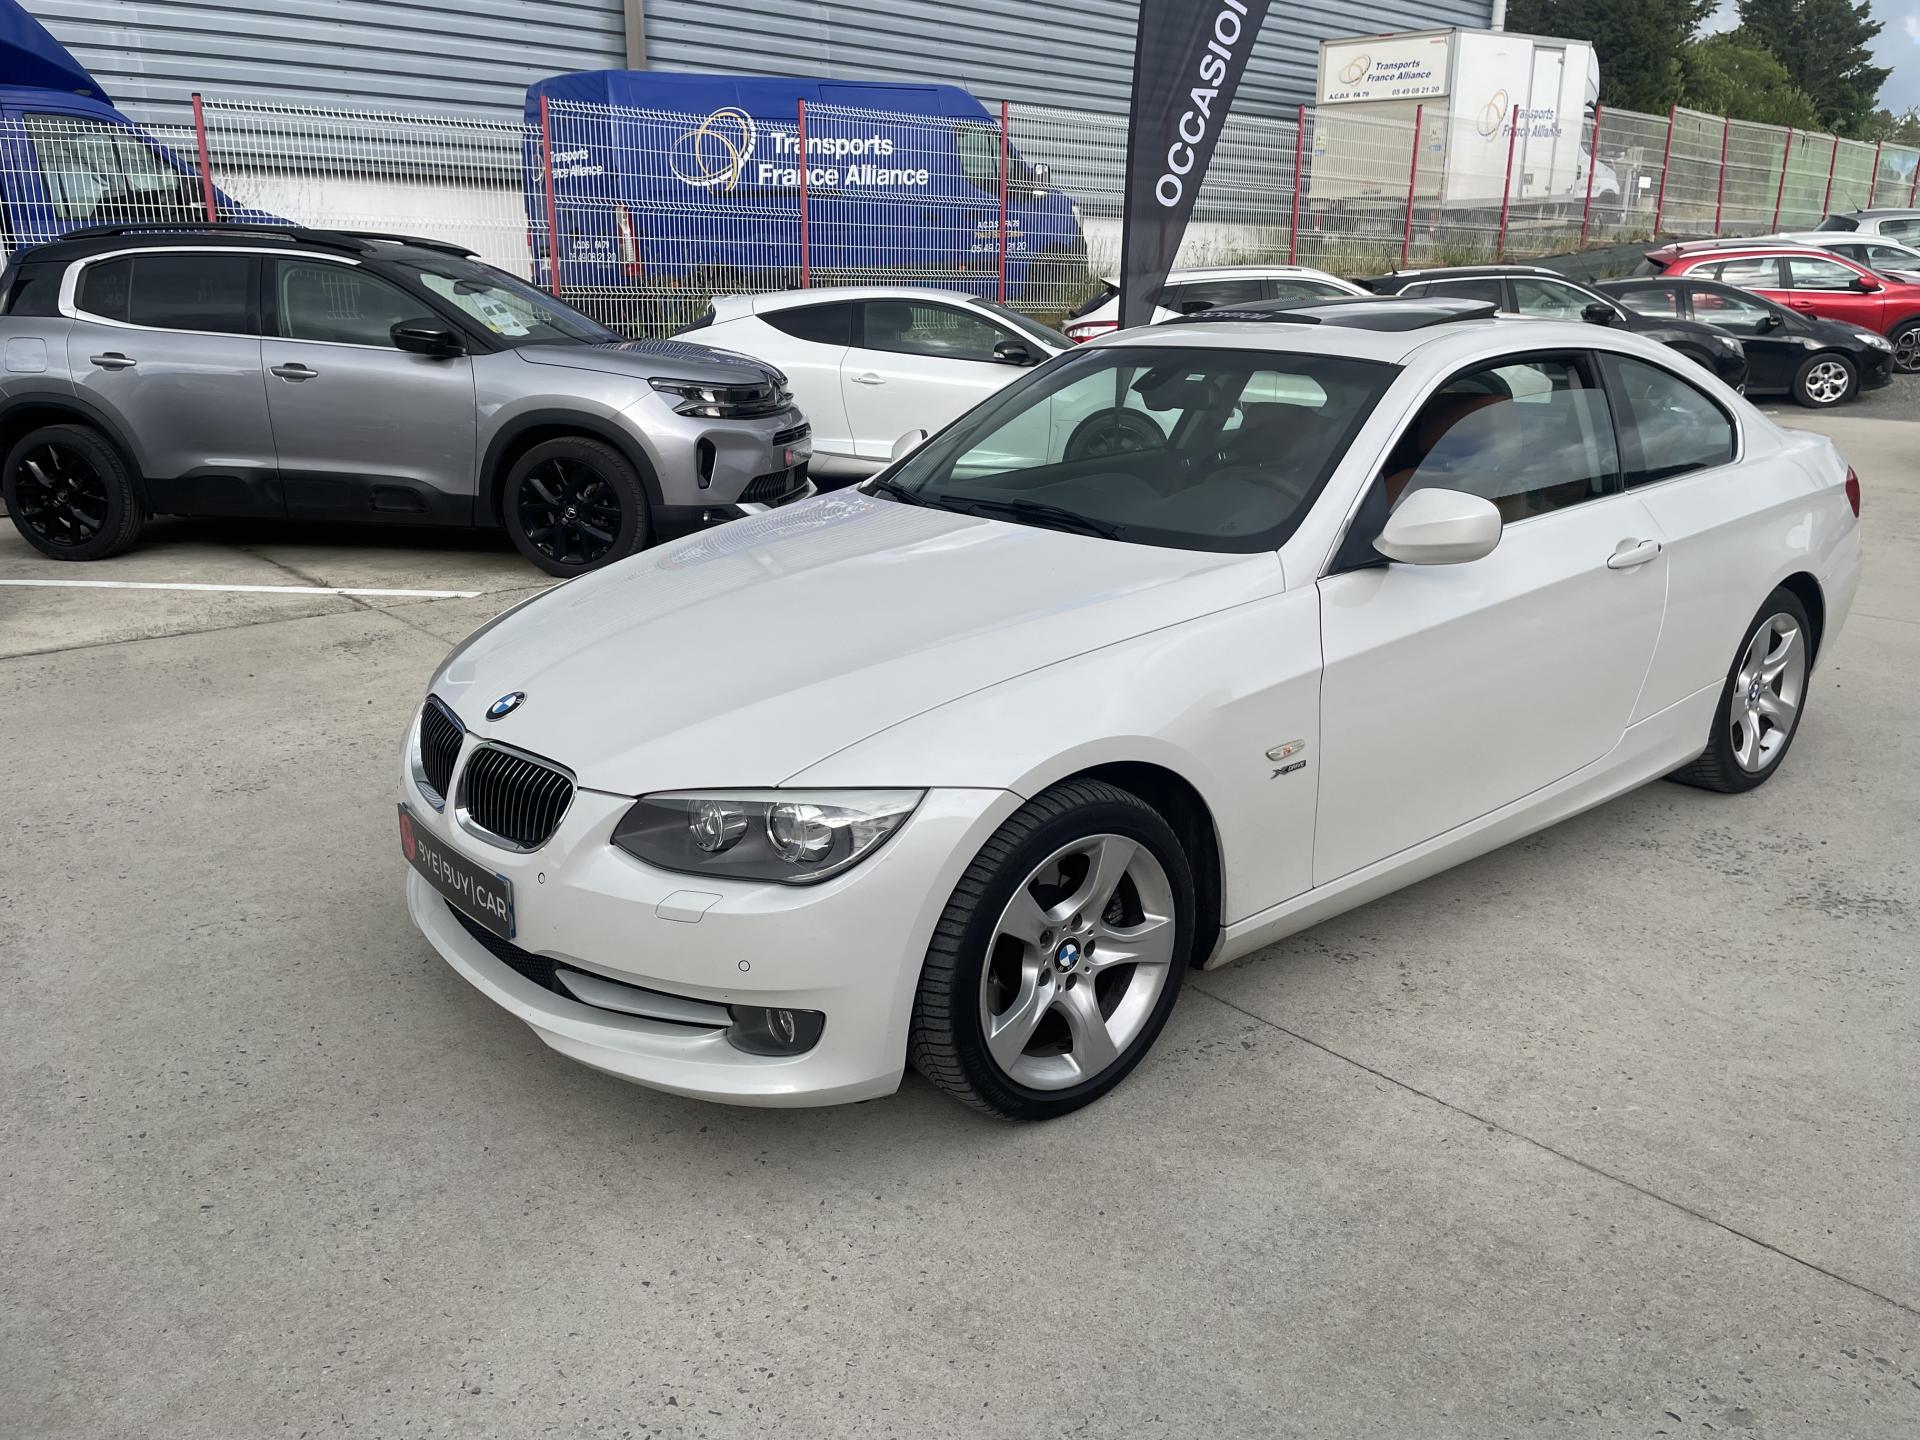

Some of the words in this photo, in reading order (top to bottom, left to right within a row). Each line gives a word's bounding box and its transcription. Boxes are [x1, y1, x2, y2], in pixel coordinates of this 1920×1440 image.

[1375, 60, 1420, 71] Transports
[1366, 73, 1395, 83] France
[1396, 71, 1432, 81] Alliance
[1502, 124, 1530, 137] Frnce
[770, 133, 893, 159] Transports
[550, 149, 588, 163] Transports
[570, 164, 602, 176] Alliance
[758, 163, 839, 186] France
[845, 164, 928, 185] Alliance
